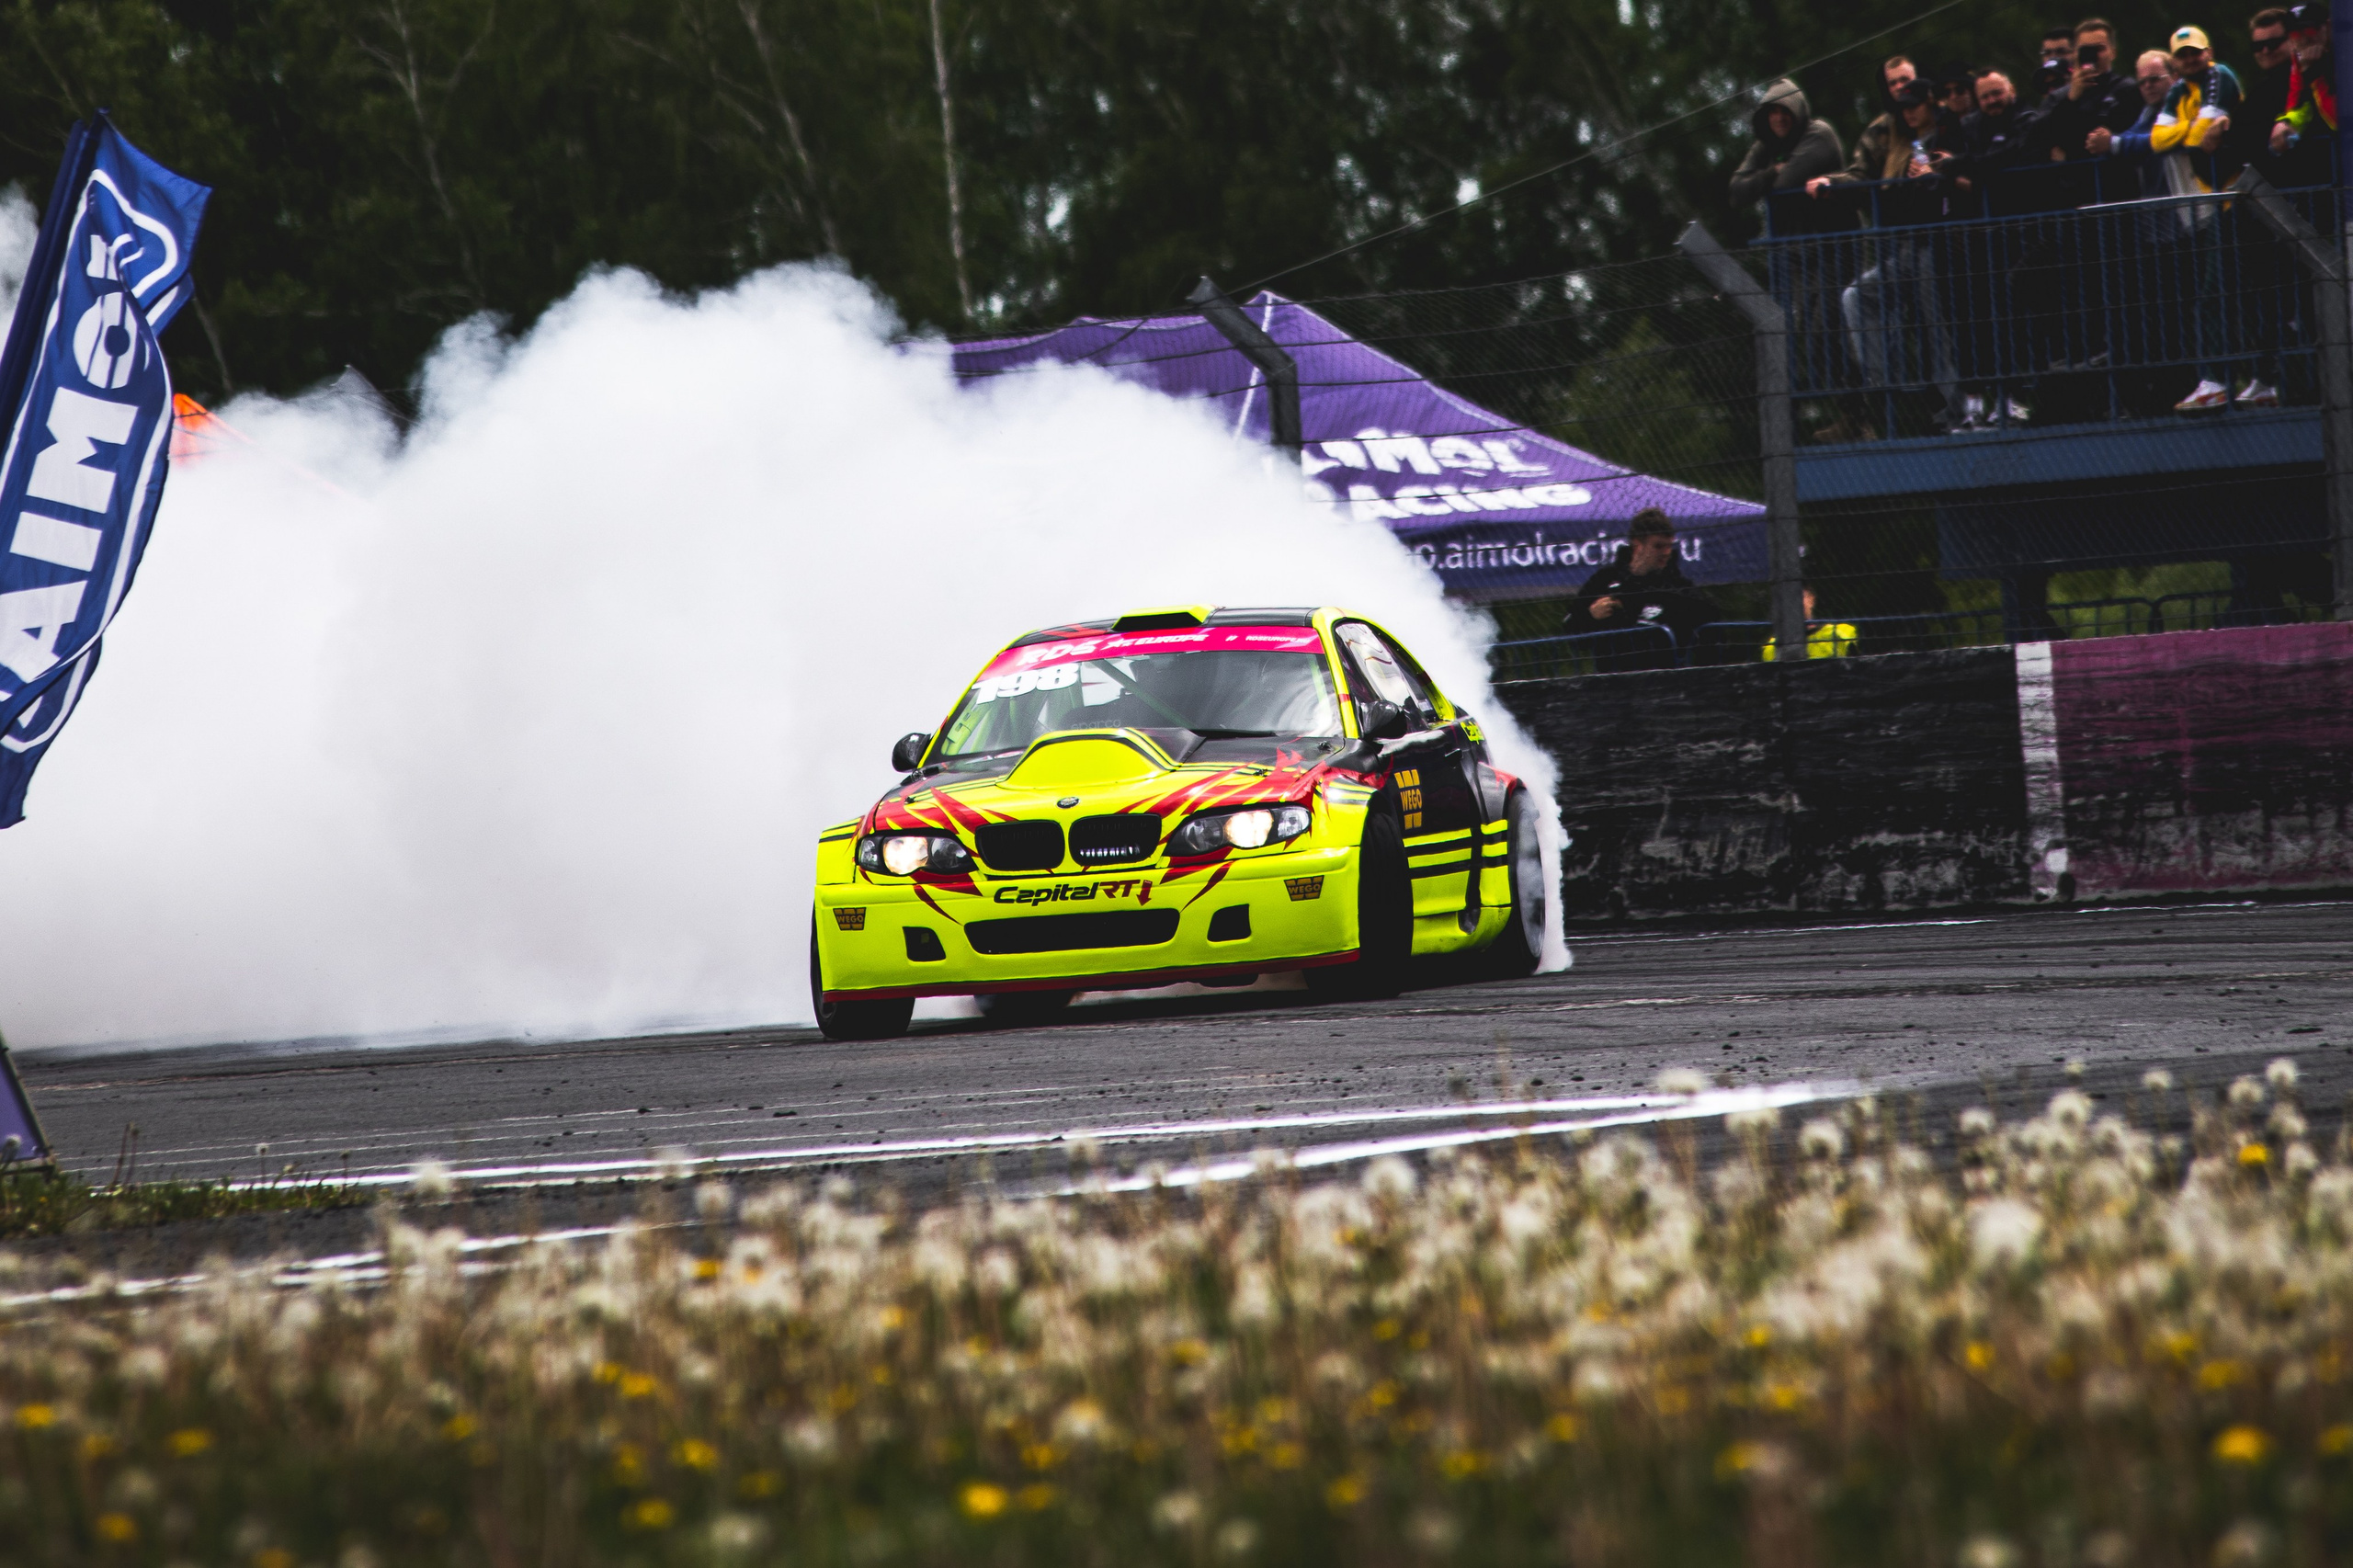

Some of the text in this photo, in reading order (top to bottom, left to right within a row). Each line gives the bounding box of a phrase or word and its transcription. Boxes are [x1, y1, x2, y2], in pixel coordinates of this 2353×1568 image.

[1017, 639, 1103, 666] RDS
[1134, 634, 1209, 646] EUROPE
[971, 663, 1079, 705] 198
[1400, 789, 1423, 812] WEGO
[1288, 883, 1321, 894] WEGO
[837, 915, 864, 923] WEGO
